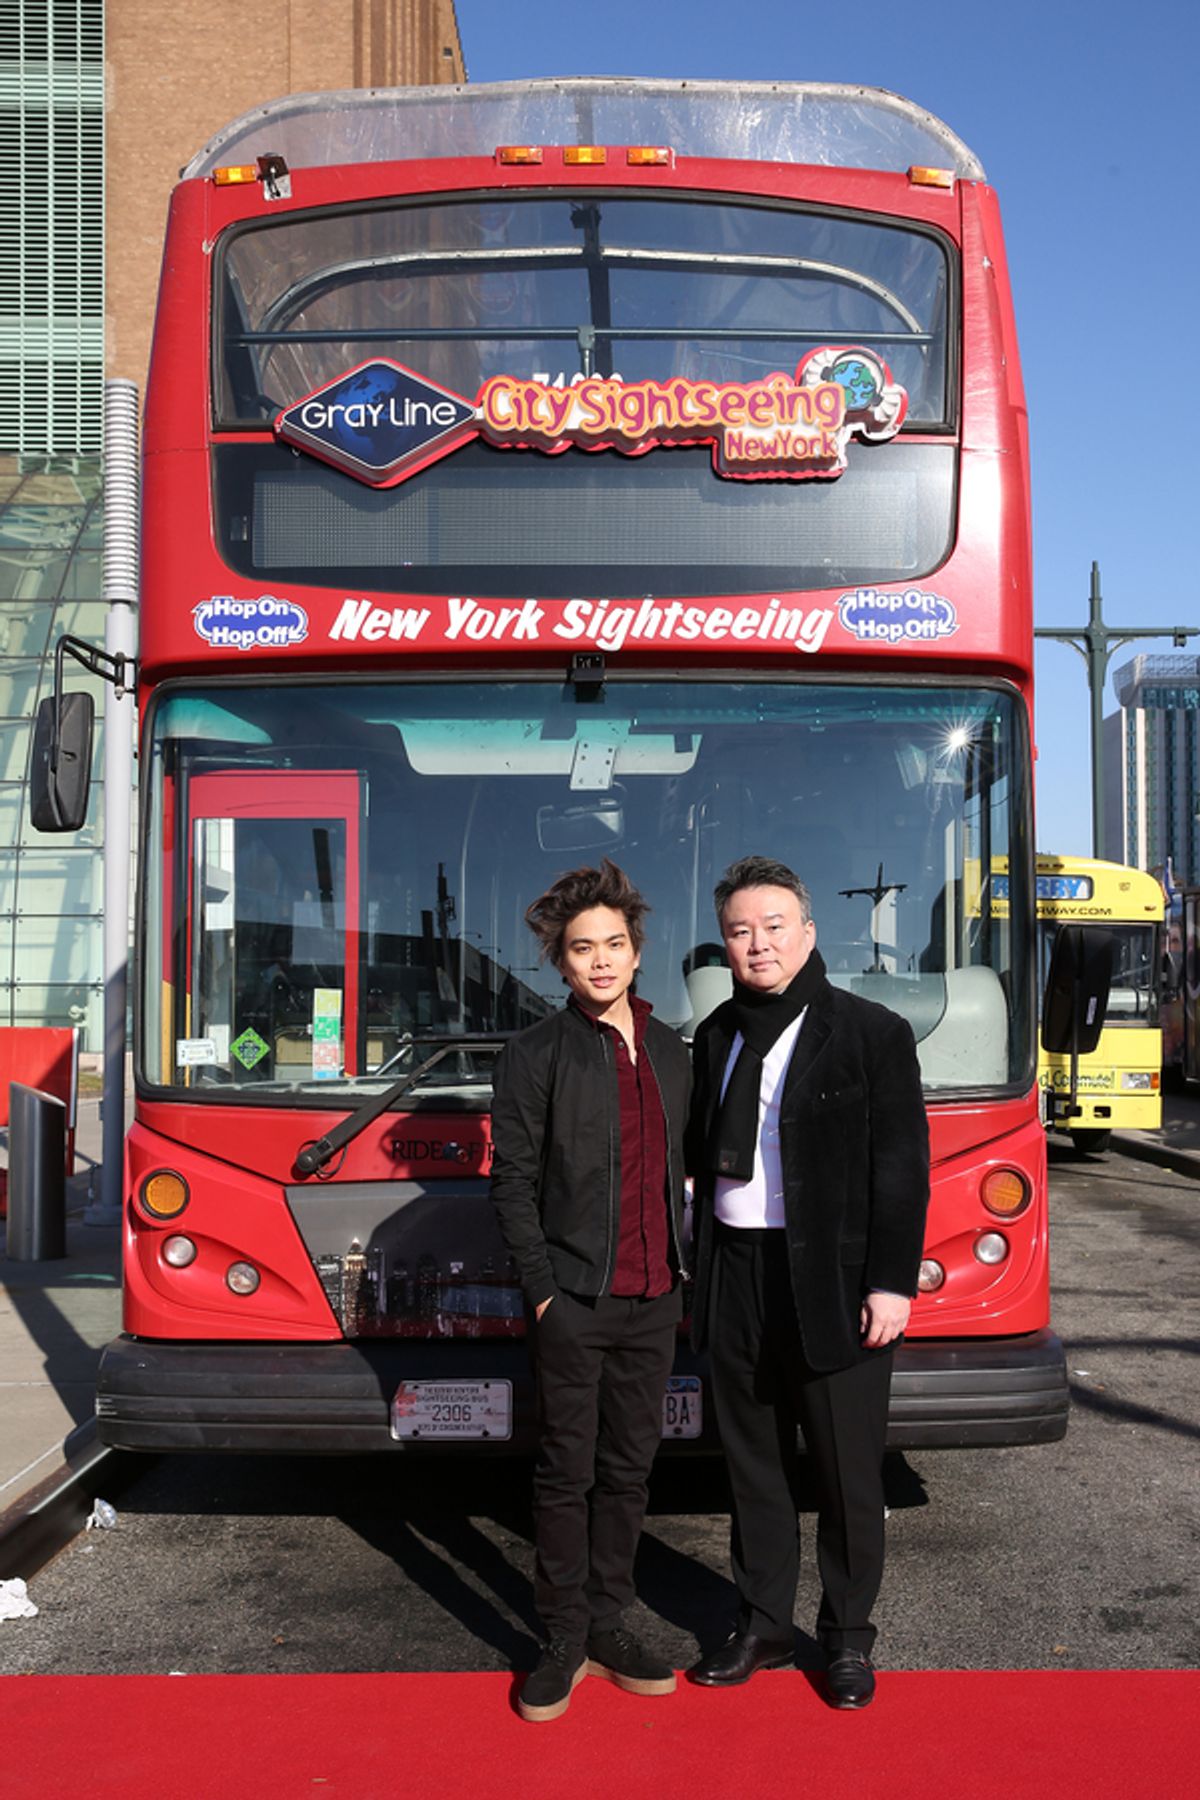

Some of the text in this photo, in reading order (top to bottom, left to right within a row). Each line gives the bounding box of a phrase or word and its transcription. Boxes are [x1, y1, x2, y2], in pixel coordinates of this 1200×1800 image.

[301, 398, 457, 428] Gray Line
[485, 377, 844, 435] City Sightseeing
[328, 598, 834, 652] New York Sightseeing
[391, 1140, 443, 1160] RIDE
[431, 1404, 471, 1421] 2306
